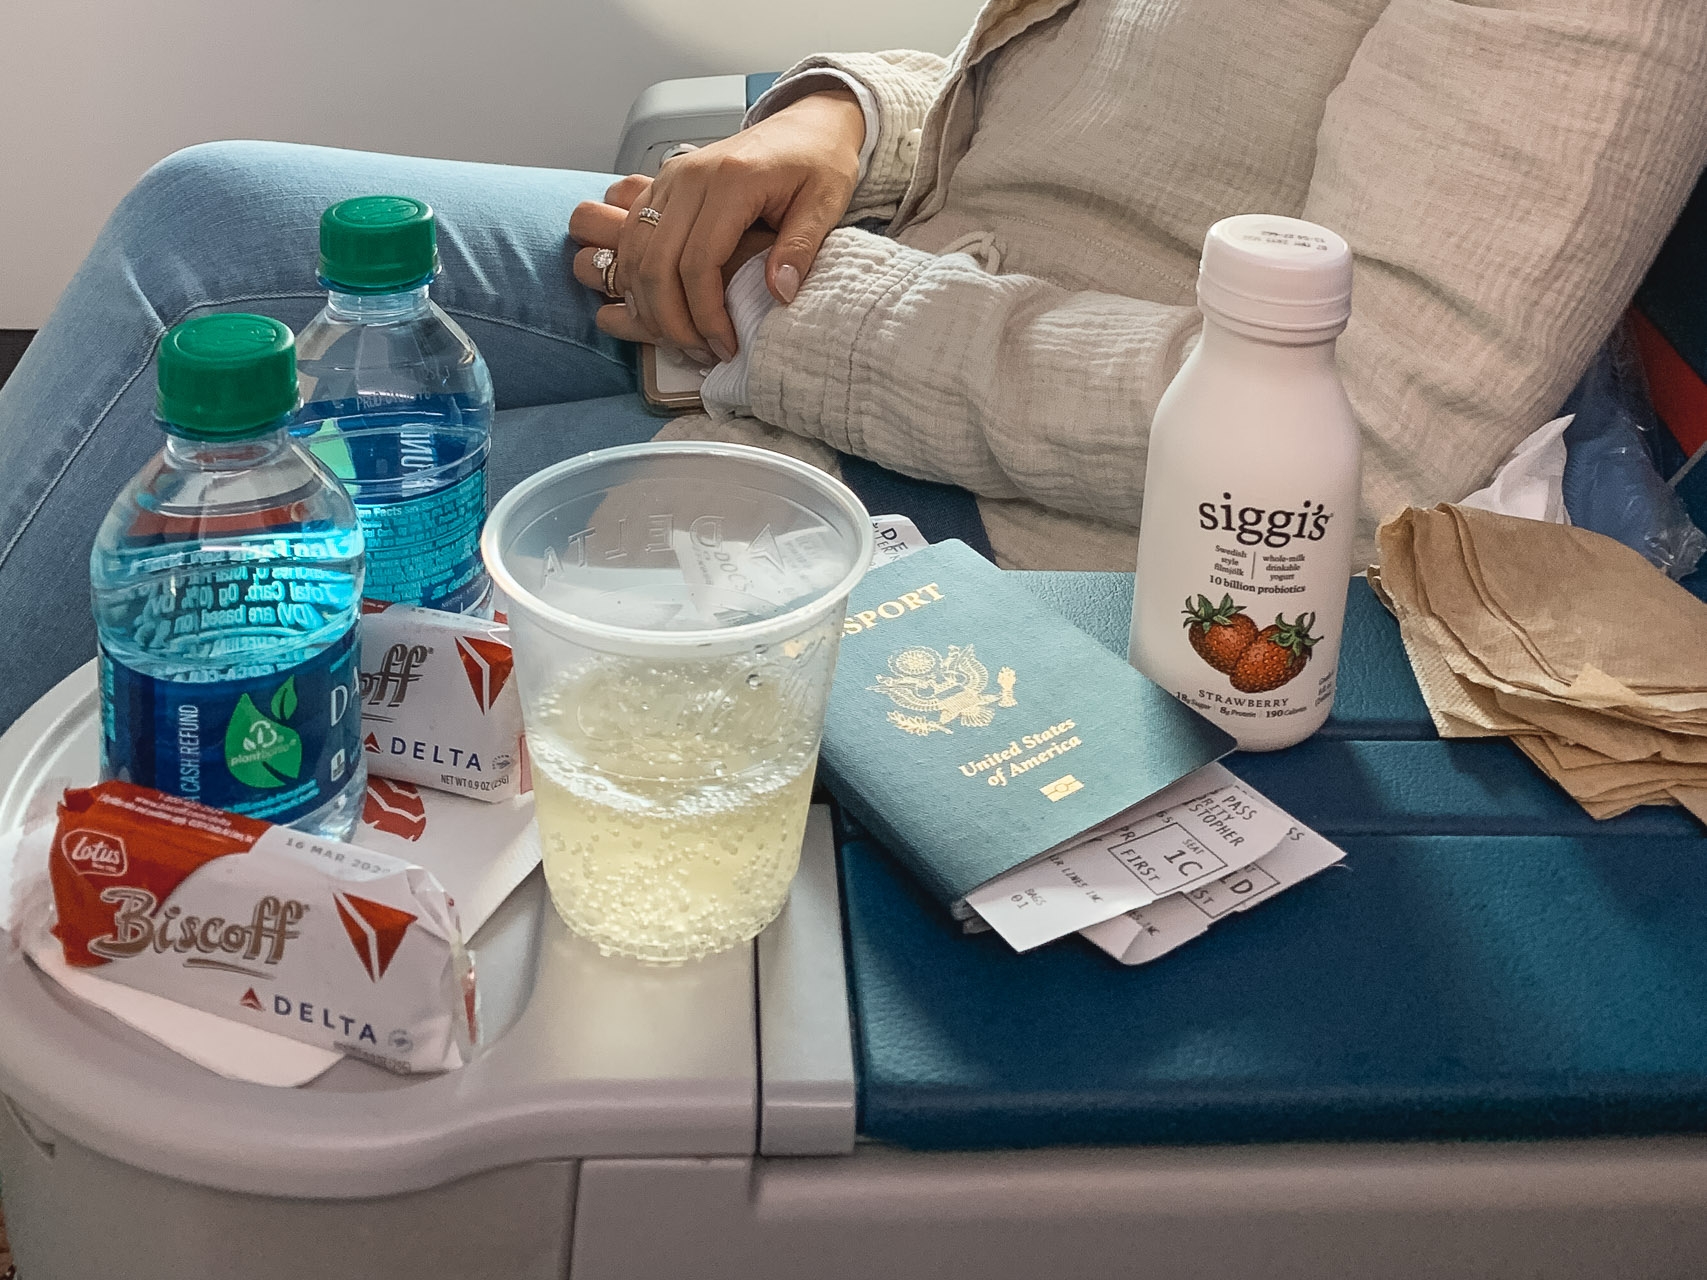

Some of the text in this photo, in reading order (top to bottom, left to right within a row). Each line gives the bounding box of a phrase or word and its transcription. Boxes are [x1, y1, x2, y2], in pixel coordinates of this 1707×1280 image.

[1199, 492, 1330, 548] siggi's
[1215, 545, 1247, 558] Swedish
[1221, 556, 1239, 566] style
[1262, 554, 1305, 562] whole-milk
[1266, 563, 1301, 572] drinkable
[1270, 573, 1295, 582] yogurt
[1210, 575, 1306, 595] 10 billion probiotics
[1198, 689, 1289, 708] STRAWBERRY
[1266, 709, 1283, 718] 190
[178, 704, 200, 758] REFUND
[391, 737, 482, 771] DELTA
[958, 718, 1076, 777] United States
[988, 735, 1082, 786] of America
[180, 758, 200, 793] CASH
[441, 774, 454, 785] NET
[455, 776, 467, 787] WT
[468, 779, 480, 790] 0.9
[480, 781, 490, 791] OZ
[1222, 795, 1257, 821] PASS
[72, 836, 120, 864] Lotus
[286, 837, 304, 850] 16
[310, 845, 346, 862] MAR
[1182, 838, 1205, 855] SEAT
[1120, 848, 1160, 882] FIRST
[1164, 849, 1203, 877] 1C
[87, 886, 303, 964] Biscoff
[274, 993, 377, 1045] DELTA
